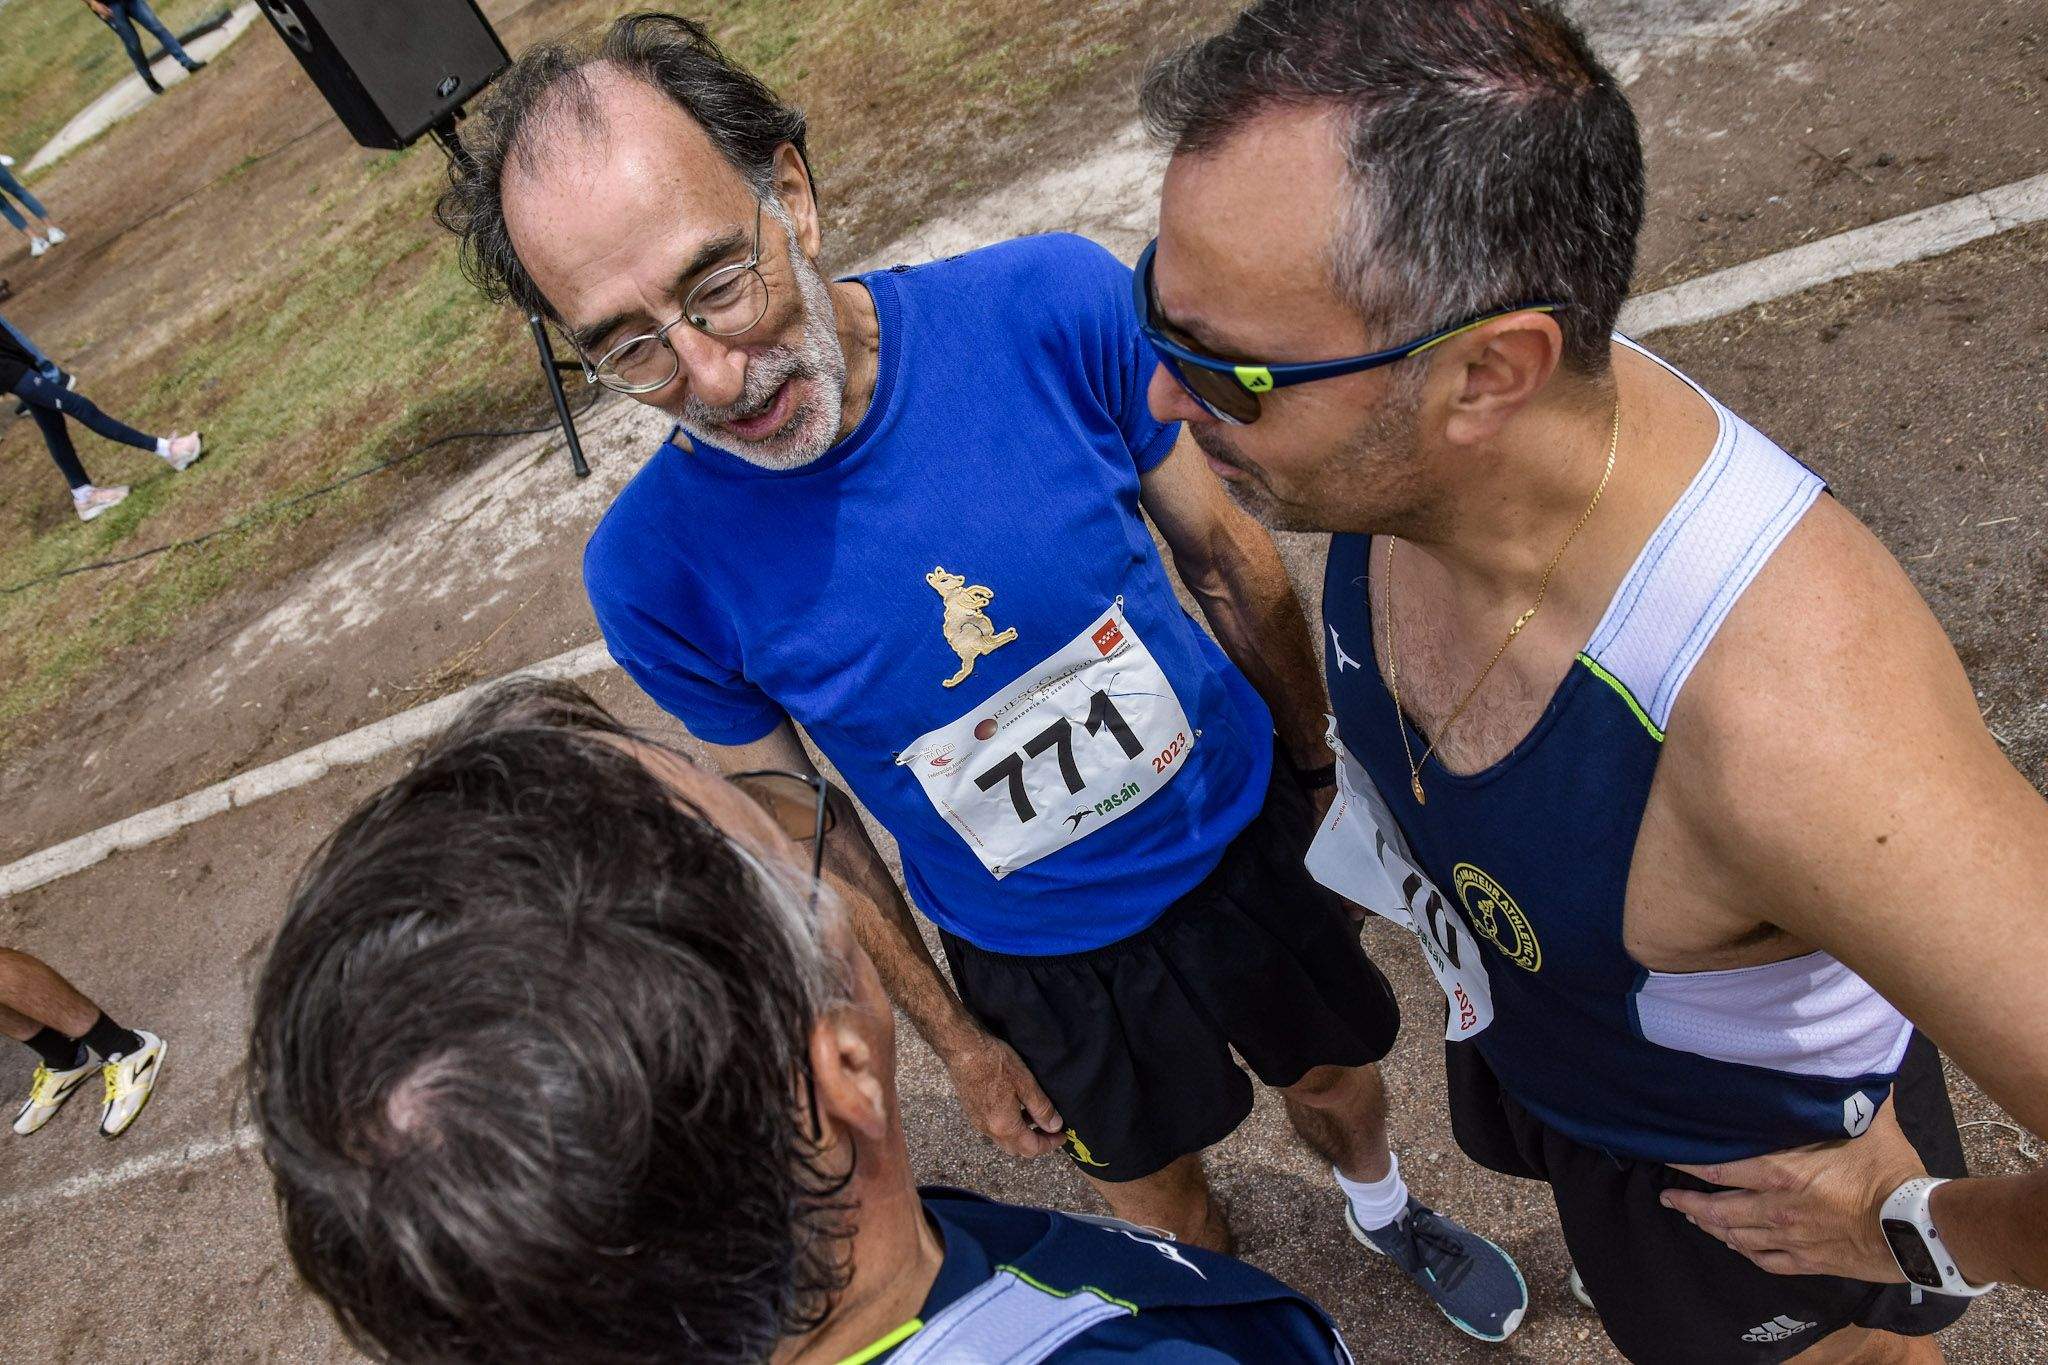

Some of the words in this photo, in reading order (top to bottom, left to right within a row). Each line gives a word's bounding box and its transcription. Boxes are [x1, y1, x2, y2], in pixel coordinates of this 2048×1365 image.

[993, 675, 1053, 720] RIESGO
[974, 689, 1145, 824] 771
[1152, 732, 1187, 774] 2023
[1094, 781, 1141, 818] rasán
[1500, 900, 1535, 958] ATHLETIC
[1453, 982, 1477, 1031] 2023
[1741, 1321, 1818, 1343] adidas
